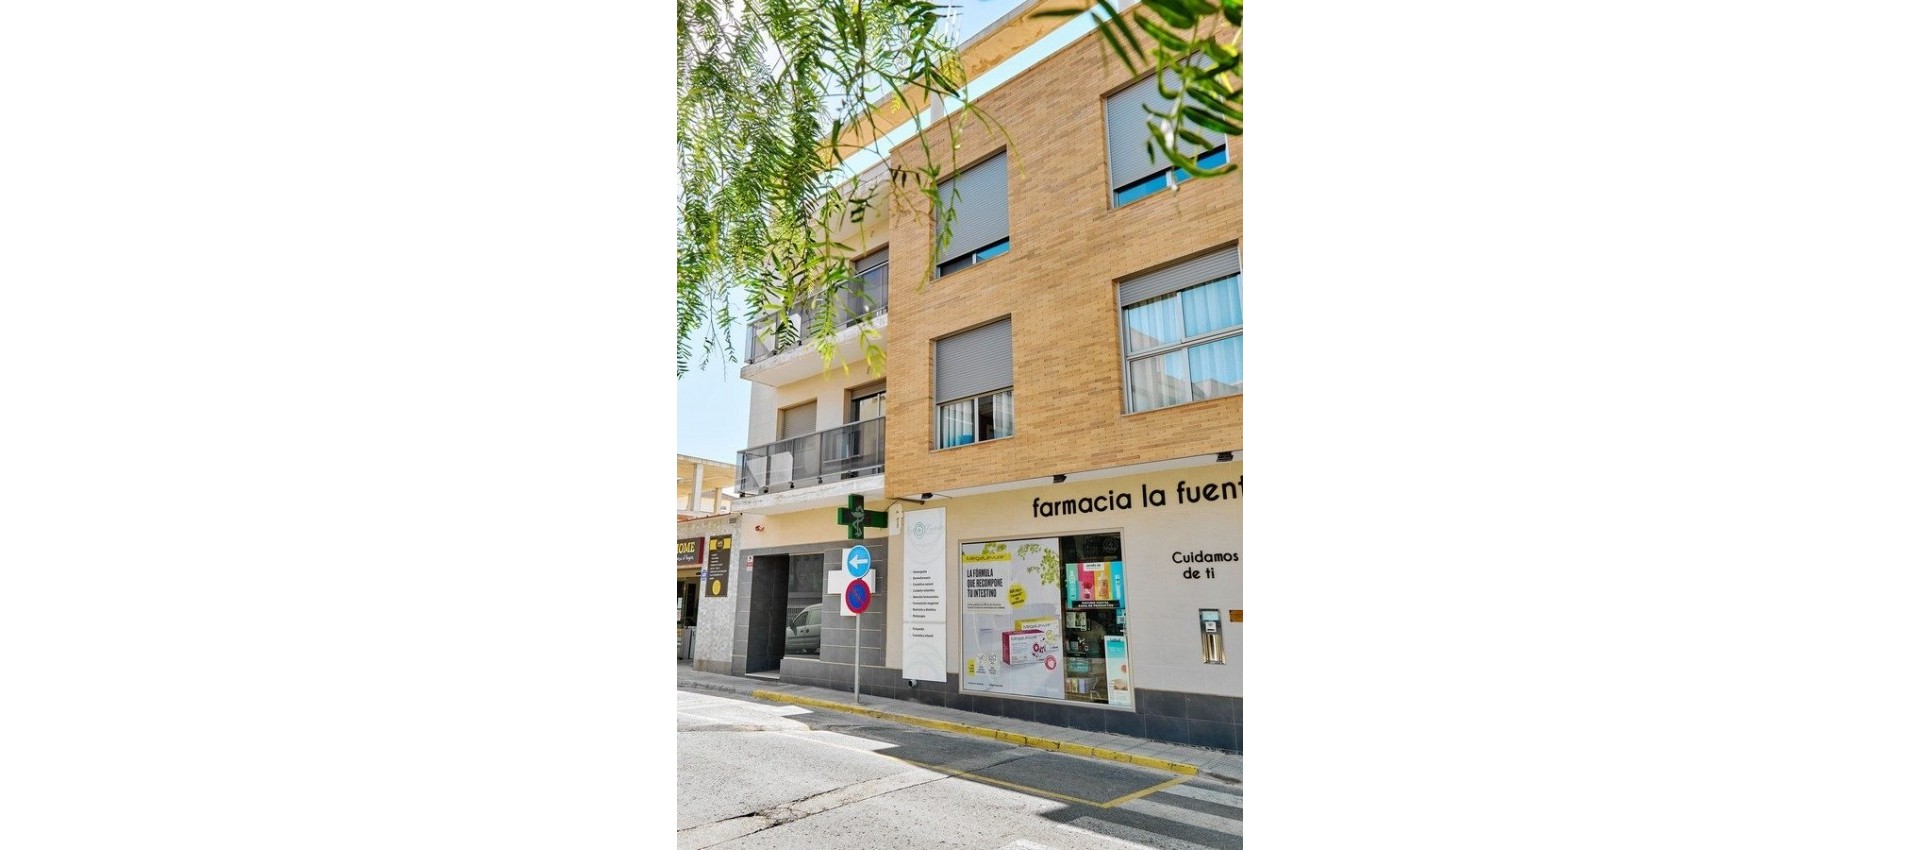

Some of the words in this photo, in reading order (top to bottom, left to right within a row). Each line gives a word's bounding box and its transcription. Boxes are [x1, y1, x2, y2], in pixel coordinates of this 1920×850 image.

[1033, 489, 1132, 518] farmacia
[1142, 483, 1166, 508] la
[1172, 550, 1239, 564] Cuidamos
[967, 569, 973, 578] LA
[973, 568, 993, 578] FÓRMULA
[1183, 567, 1201, 579] de
[1205, 567, 1215, 579] ti
[967, 579, 976, 588] QUE
[976, 578, 1003, 588] RECOMPONE
[967, 589, 973, 598] TU
[974, 589, 997, 598] INTESTINO
